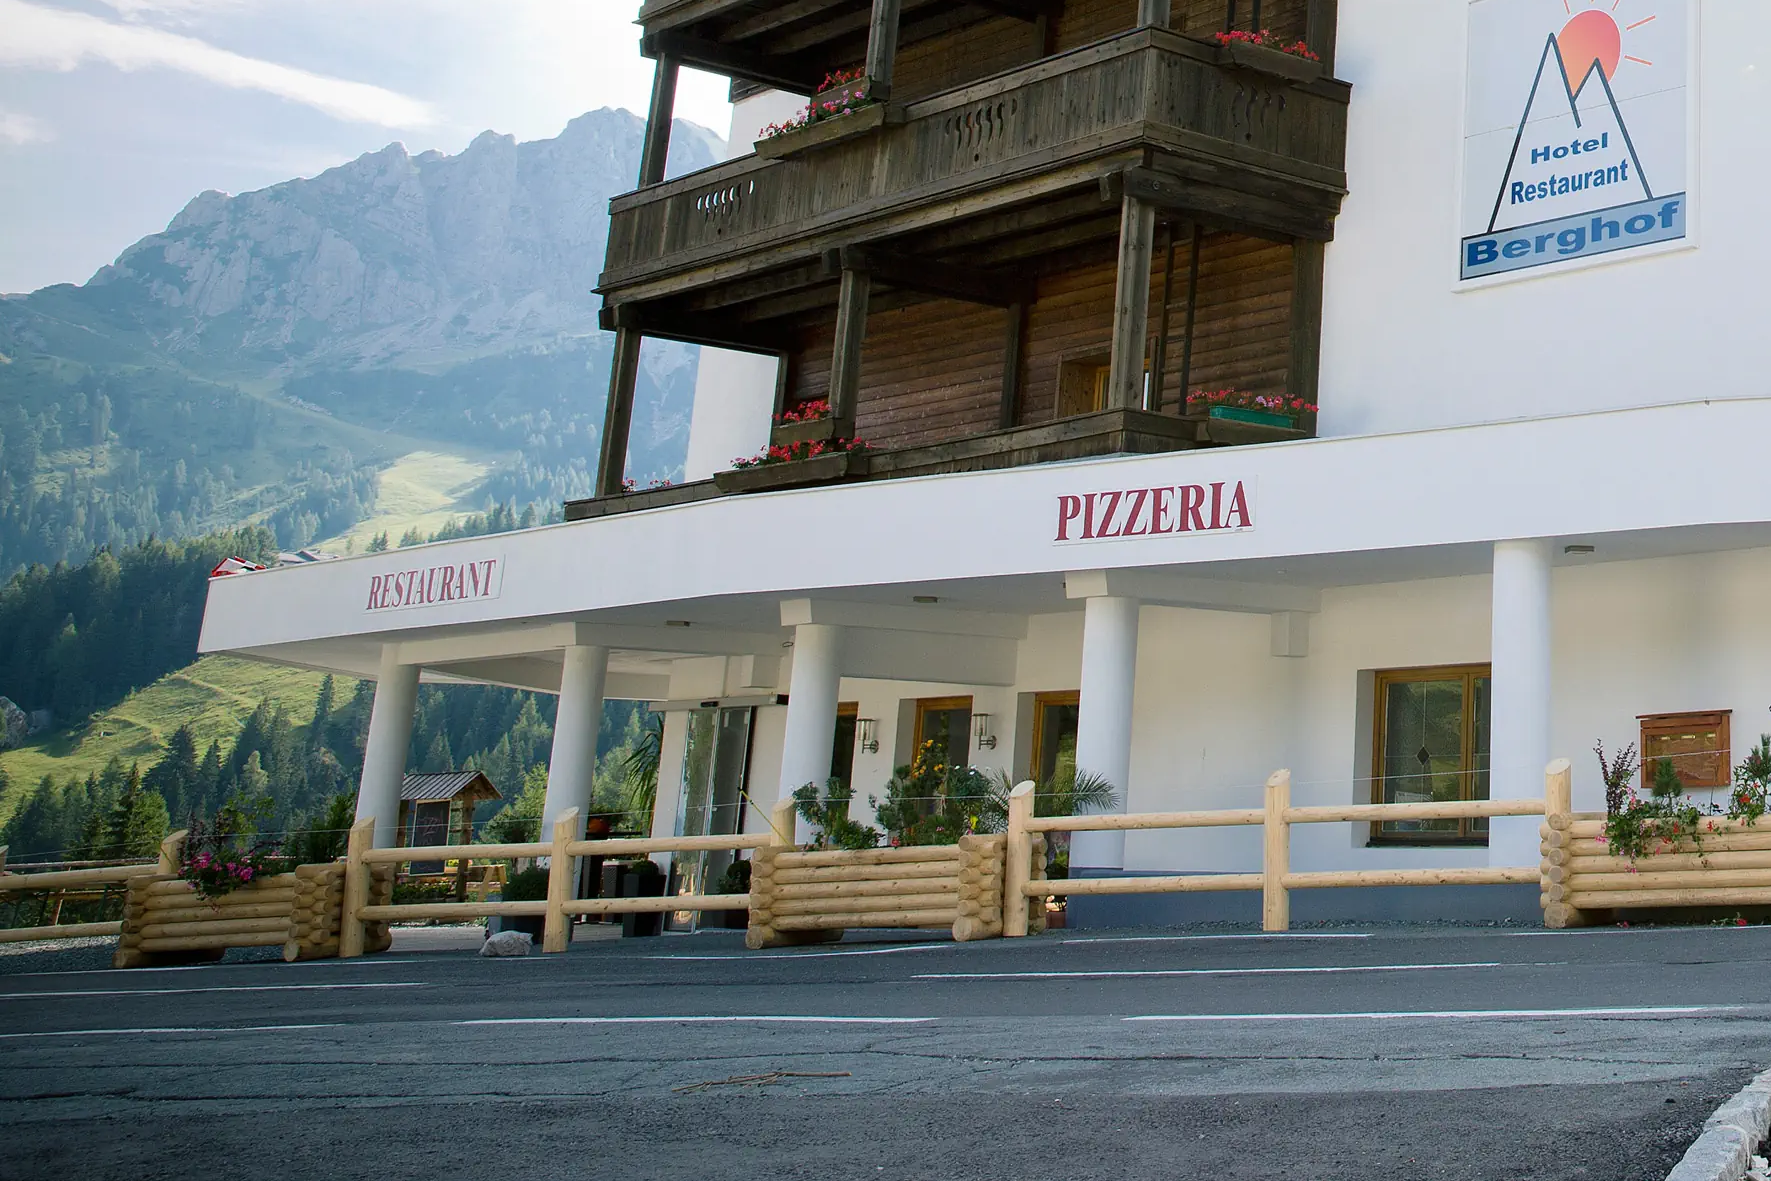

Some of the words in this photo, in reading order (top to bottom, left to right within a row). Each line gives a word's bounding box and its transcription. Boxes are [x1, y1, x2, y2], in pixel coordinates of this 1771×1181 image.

[1530, 132, 1609, 164] Hotel
[1511, 158, 1628, 205] Restaurant
[1466, 201, 1680, 267] Berghof
[1054, 480, 1252, 542] PIZZERIA
[366, 559, 497, 611] RESTAURANT
